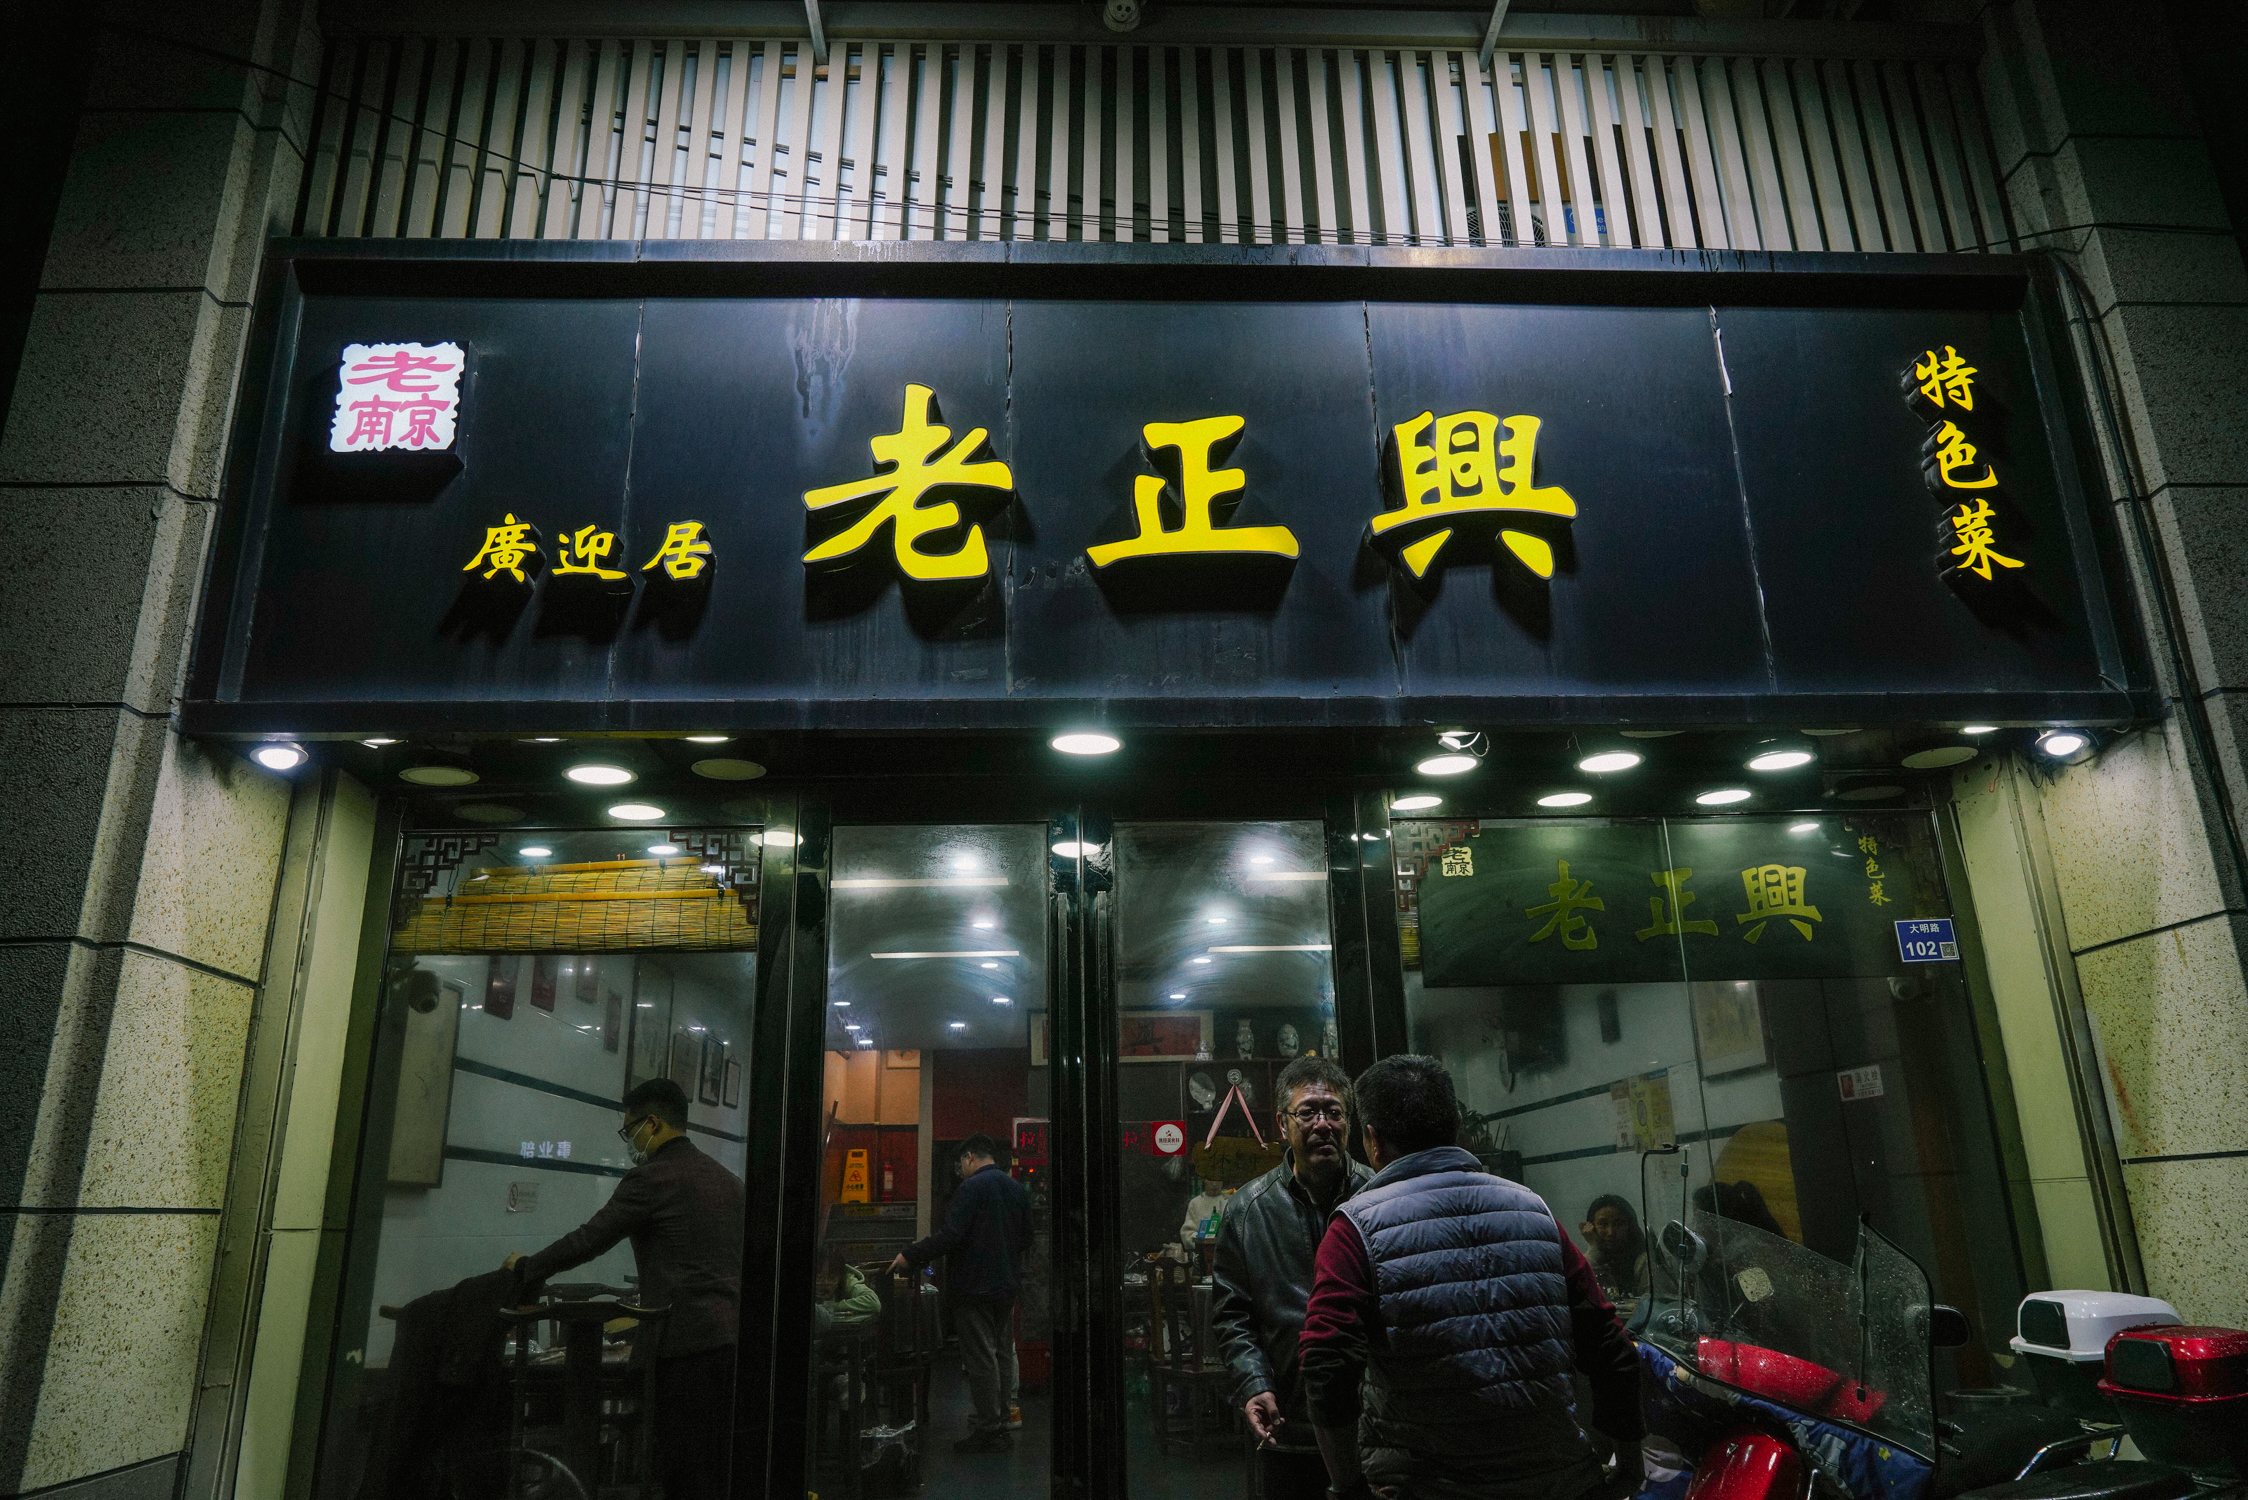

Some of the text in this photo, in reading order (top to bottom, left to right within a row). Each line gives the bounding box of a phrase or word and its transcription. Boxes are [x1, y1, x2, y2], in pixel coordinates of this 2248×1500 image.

[347, 350, 456, 392] 老
[346, 393, 450, 446] 南京
[803, 383, 1578, 580] 老正興
[1916, 345, 2025, 581] 特色菜
[462, 512, 712, 583] 廣迎居
[1525, 859, 1823, 951] 老正興
[1857, 835, 1893, 907] 特色菜
[1906, 941, 1938, 957] 102
[1909, 923, 1940, 935] 大明路
